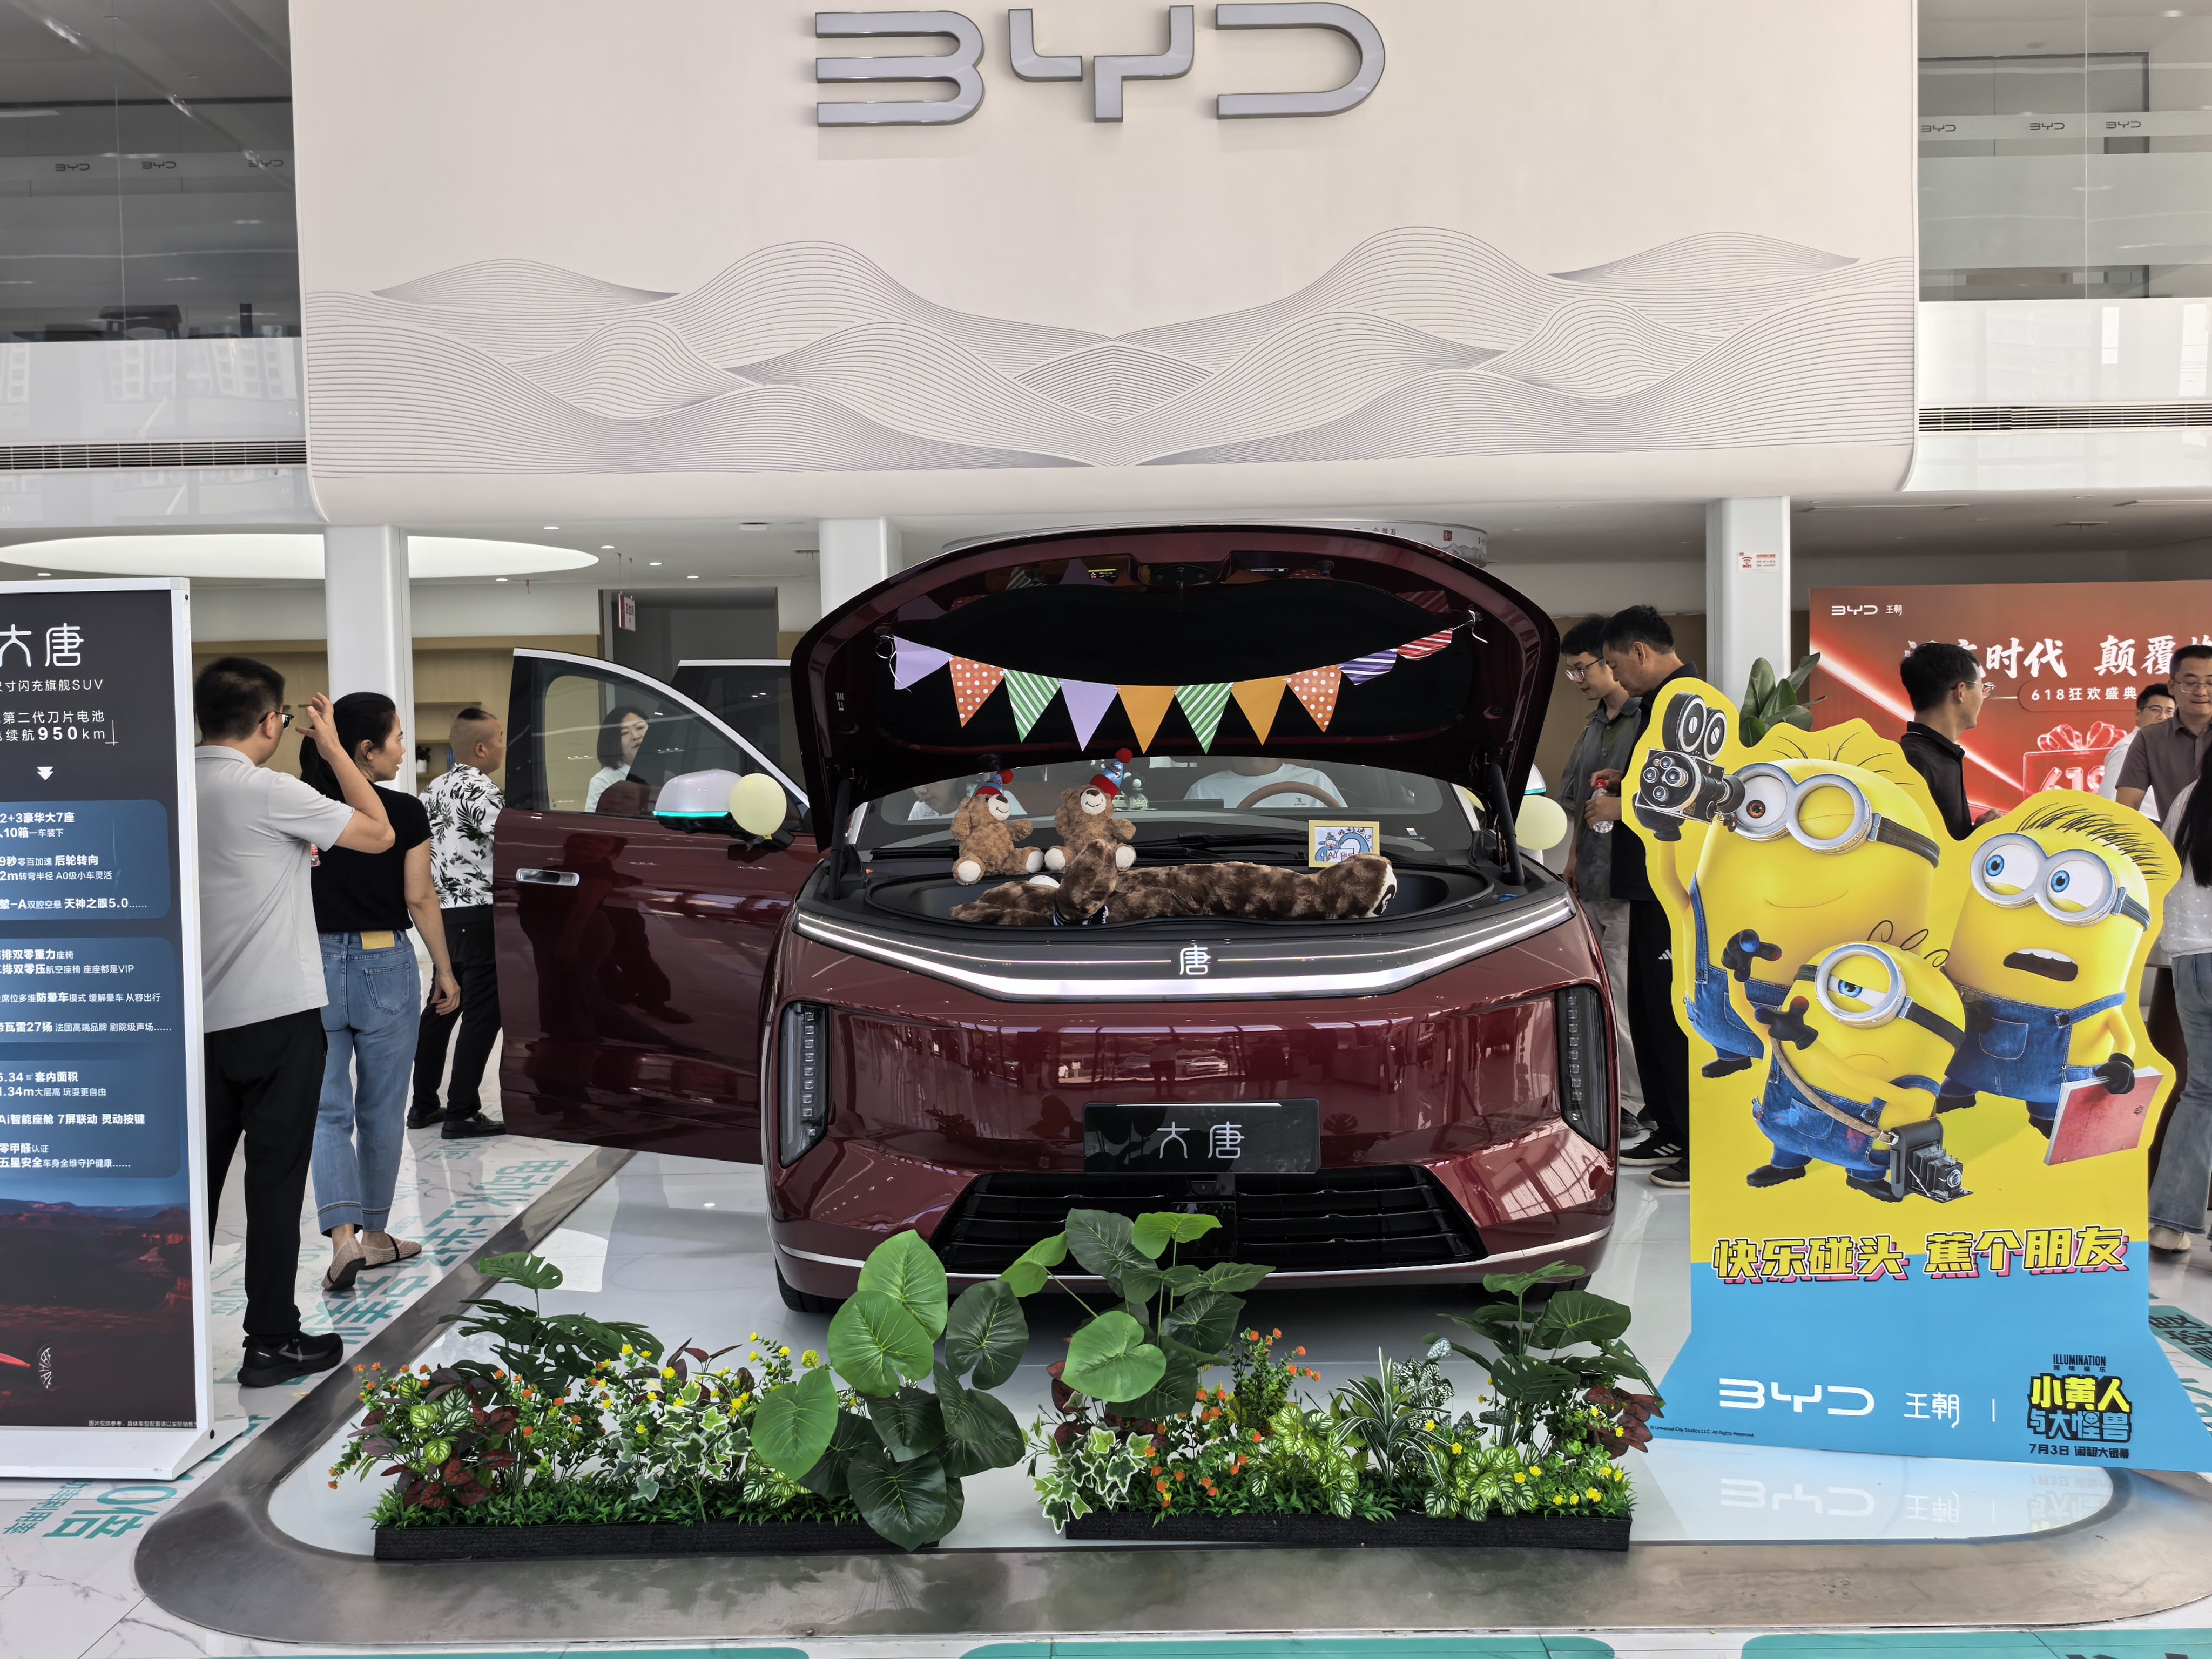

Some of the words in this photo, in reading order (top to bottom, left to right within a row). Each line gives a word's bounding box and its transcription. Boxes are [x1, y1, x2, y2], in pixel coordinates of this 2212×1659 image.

[815, 2, 1386, 127] BYD
[1921, 125, 1956, 133] BYD
[2029, 123, 2065, 131] BYD
[2106, 120, 2141, 129] BYD
[55, 164, 90, 172] BYD
[142, 161, 176, 170] BYD
[1831, 605, 1878, 616] BYD
[0, 623, 84, 667] 大唐
[2093, 634, 2212, 678] 颠覆
[0, 679, 103, 693] 寸闪充旗舰SUV
[2031, 687, 2139, 701] 618狂欢盛典
[0, 710, 105, 724] 第二代刀片电池
[55, 854, 99, 866] 后轮转向
[56, 870, 113, 881] A0级小车灵活
[0, 948, 74, 960] 排双零重力座椅
[1179, 945, 1211, 975] 唐
[0, 963, 81, 975] 排双零压航空座椅
[83, 964, 134, 974] 座座都是VIP
[0, 992, 87, 1003] 席位多维防晕车模式
[88, 993, 124, 1003] 缓解晕车
[126, 992, 161, 1002] 从容出行
[55, 1022, 108, 1033] 法国高端品牌
[63, 1087, 107, 1097] 玩耍更自由
[58, 1114, 98, 1125] 7屏联动
[102, 1113, 146, 1125] 灵动按键
[1157, 1121, 1245, 1159] 大唐
[1713, 1236, 1906, 1282] 快乐碰头
[1925, 1226, 2129, 1280] 蕉个朋友
[2053, 1354, 2106, 1366] ILLUMINATION
[1719, 1378, 1875, 1417] BYD
[2030, 1375, 2130, 1413] 小黄人
[2029, 1408, 2130, 1442] 与大怪兽
[2029, 1444, 2069, 1456] 7月3日
